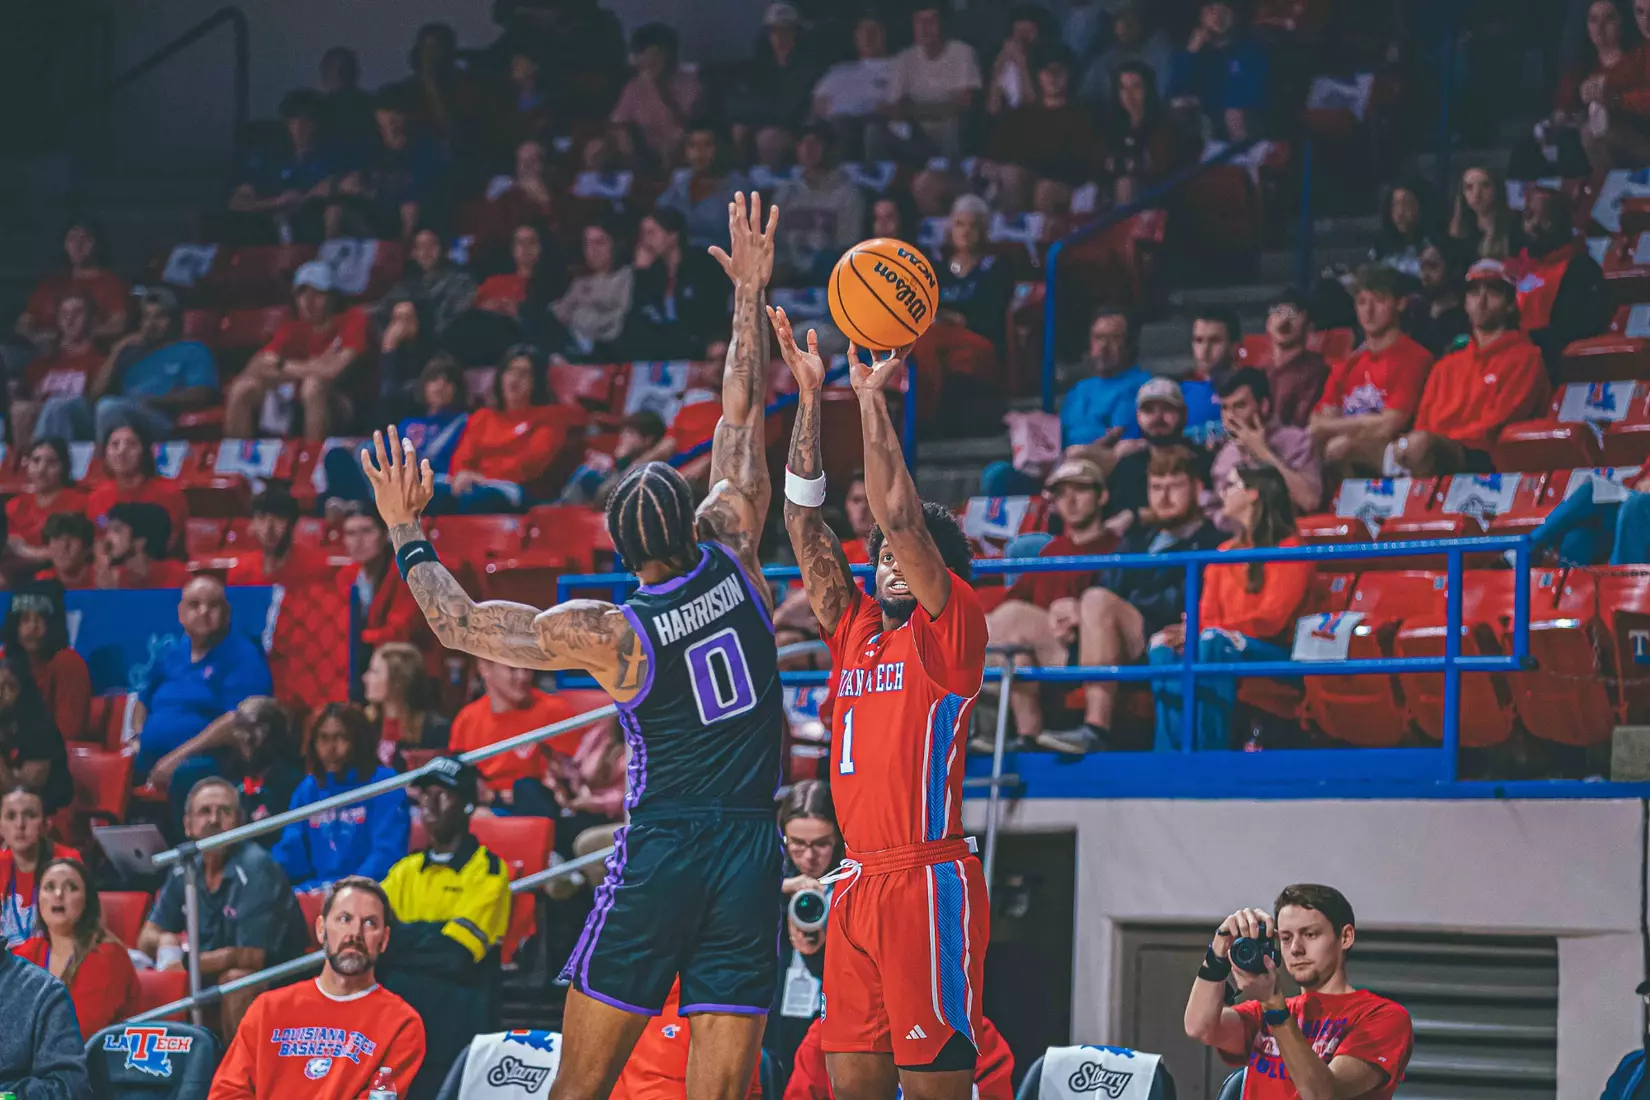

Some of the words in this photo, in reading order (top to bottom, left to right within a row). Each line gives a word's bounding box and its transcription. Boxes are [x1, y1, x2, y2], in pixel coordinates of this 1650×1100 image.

[873, 261, 927, 324] Wilson
[897, 248, 936, 288] NCAA
[652, 572, 745, 646] HARRISON
[684, 627, 757, 725] 0
[839, 707, 855, 776] 1
[271, 1027, 346, 1043] LOUISIANA
[1068, 1061, 1134, 1099] Starry
